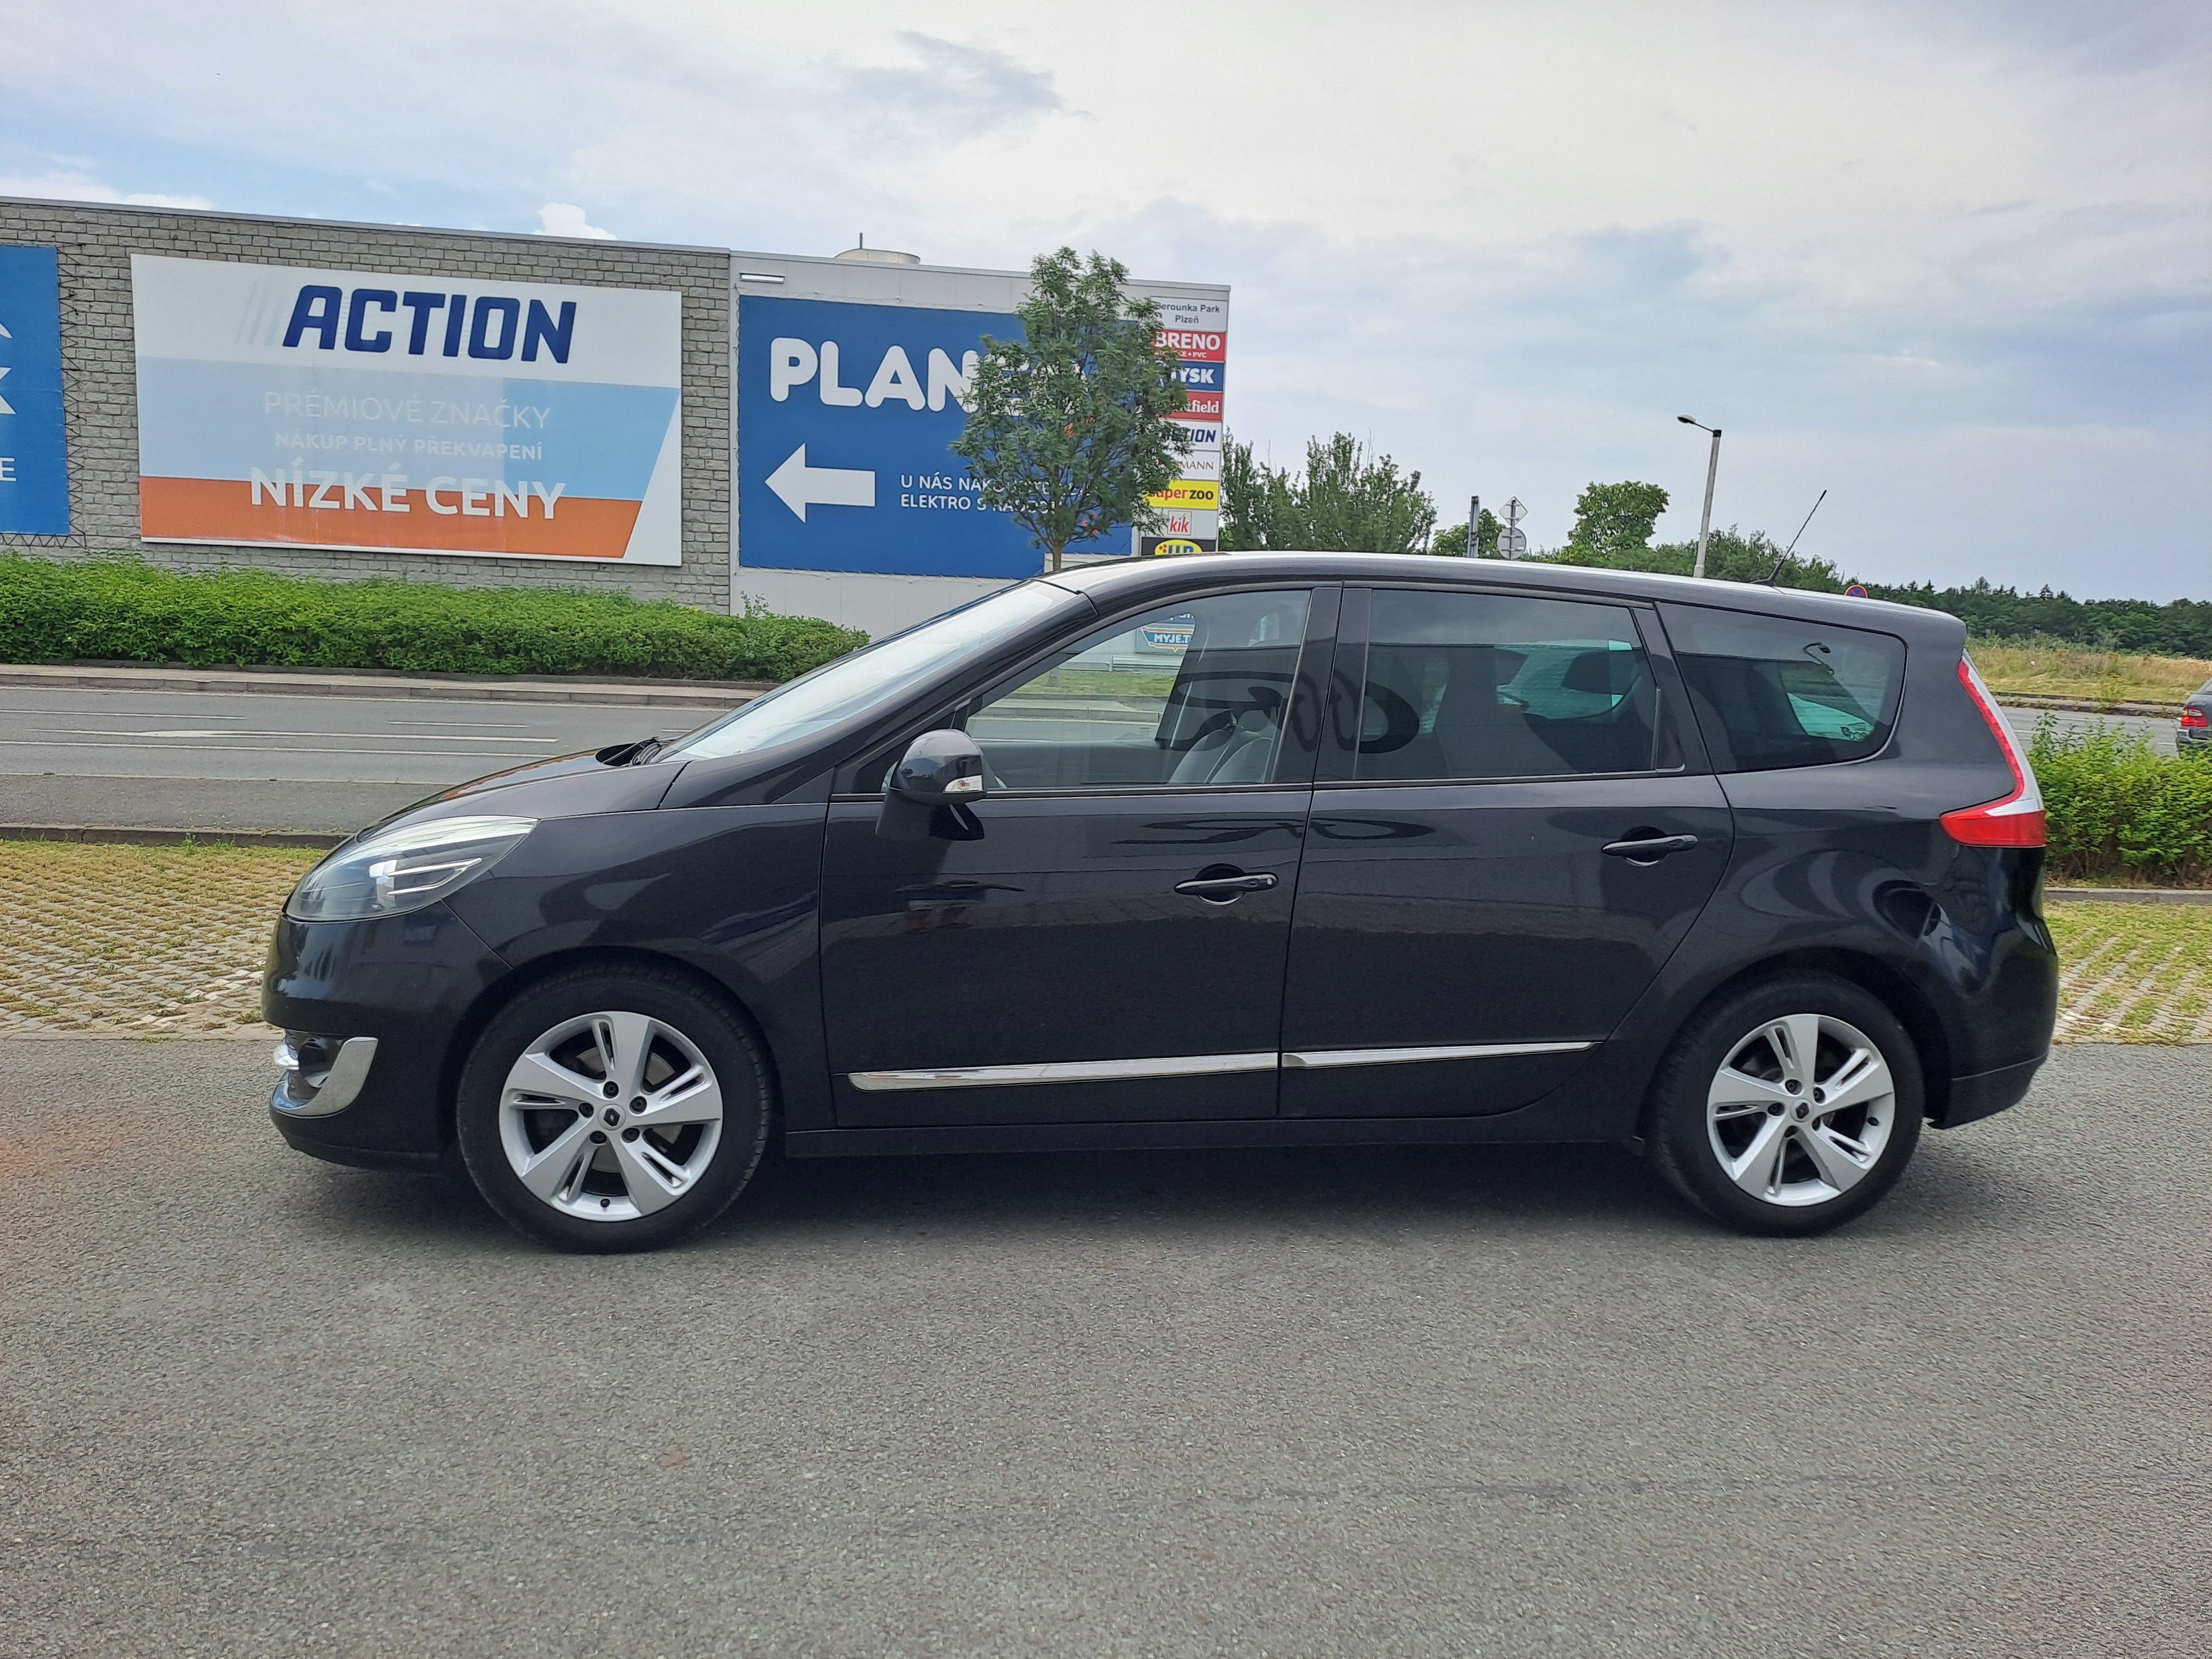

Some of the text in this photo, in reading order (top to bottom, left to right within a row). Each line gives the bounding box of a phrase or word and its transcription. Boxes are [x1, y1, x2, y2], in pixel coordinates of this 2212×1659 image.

[1200, 305, 1220, 313] Park
[283, 285, 577, 364] ACTION
[1175, 315, 1199, 324] Plzeň
[1155, 331, 1221, 351] BRENO
[265, 389, 550, 429] PRÉMIOVÉ ZNAČKY
[275, 429, 542, 461] NÁKUP PLNÝ PŘEKVAPENÍ
[251, 456, 566, 520] NÍZKÉ CENY
[901, 474, 912, 488] U
[919, 471, 952, 491] NÁS
[901, 494, 971, 510] ELEKTRO
[977, 497, 987, 511] S
